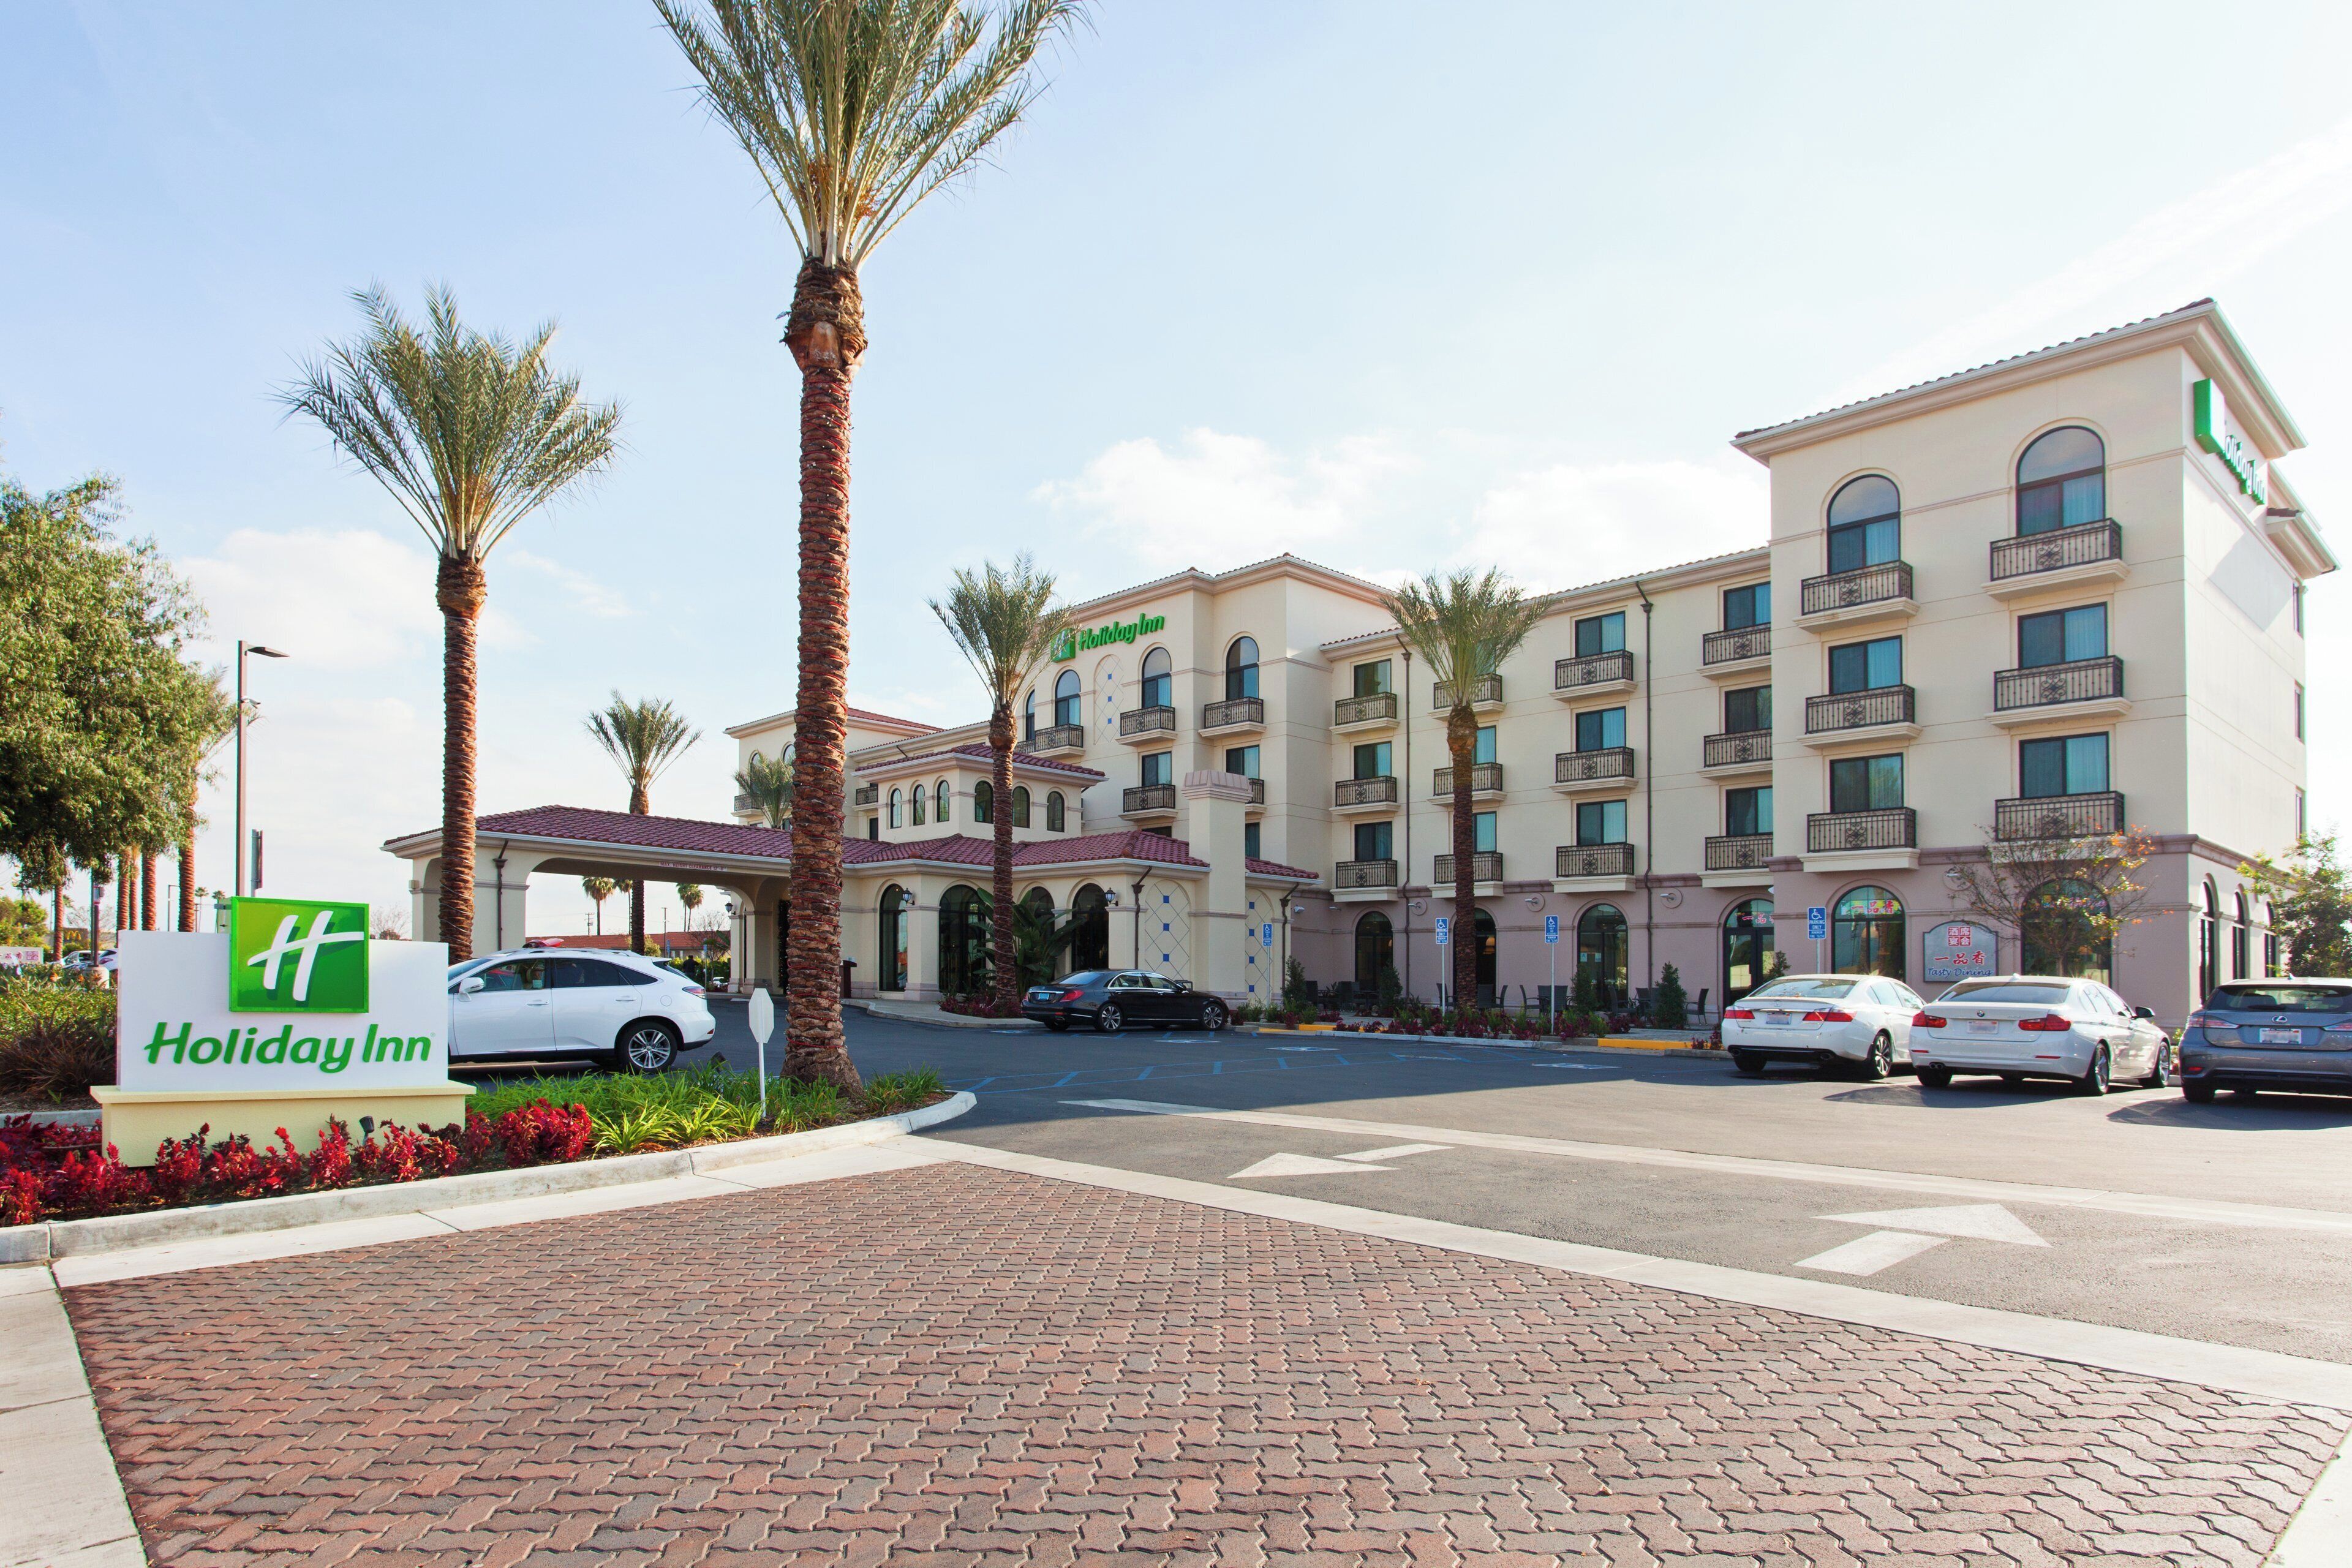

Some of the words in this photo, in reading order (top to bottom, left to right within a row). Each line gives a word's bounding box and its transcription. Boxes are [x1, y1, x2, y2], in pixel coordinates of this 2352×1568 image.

[1078, 621, 1137, 651] Holiday
[1137, 612, 1164, 635] Inn
[1934, 950, 1985, 965] 一品香
[1928, 968, 1952, 978] Tasty
[1954, 968, 1992, 977] Dining
[143, 1022, 355, 1074] Holiday
[362, 1023, 431, 1063] Inn
